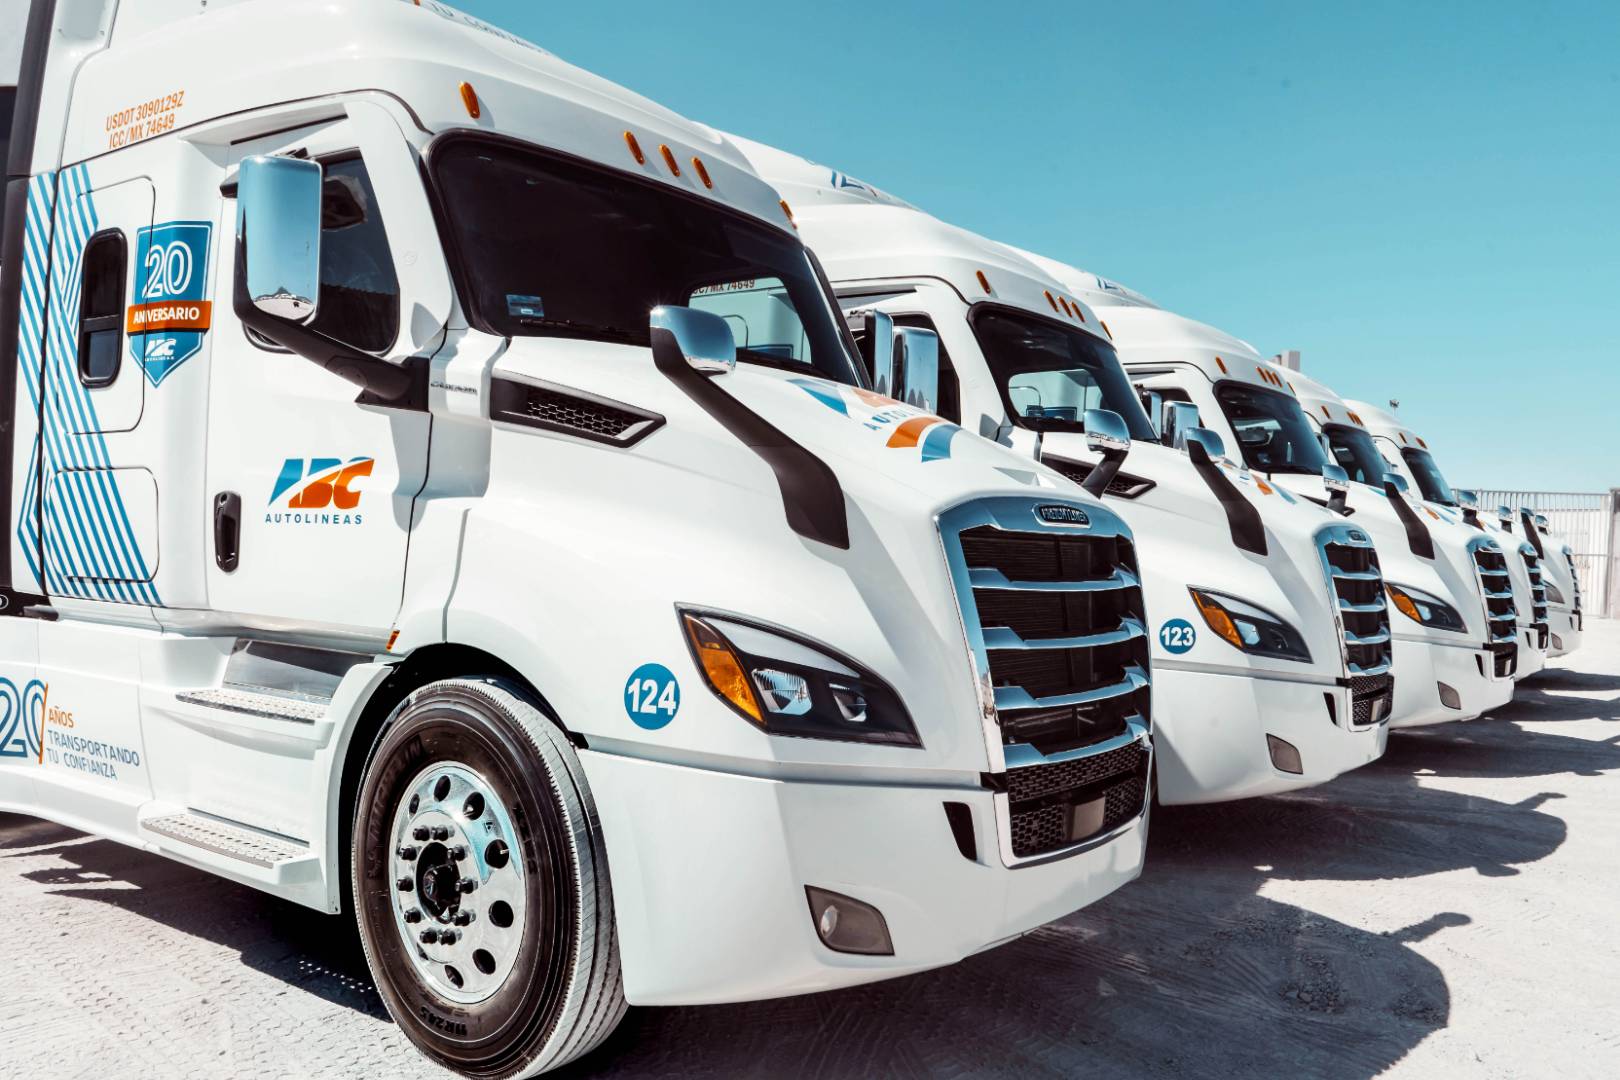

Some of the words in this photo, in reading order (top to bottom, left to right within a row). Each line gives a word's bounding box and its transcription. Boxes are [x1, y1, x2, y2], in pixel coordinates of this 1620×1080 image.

[105, 107, 135, 131] USDOT
[136, 90, 184, 121] 3090129Z
[146, 113, 175, 137] 74649
[141, 240, 193, 299] 20
[133, 306, 200, 324] ANIVERSARIO
[265, 513, 362, 525] AUTOLINEAS
[1161, 626, 1194, 647] 123
[628, 678, 677, 716] 124
[48, 705, 74, 728] AÑOS
[48, 729, 140, 767] TRANSPORTANDO
[46, 747, 59, 764] TU
[63, 752, 118, 780] CONFIANZA
